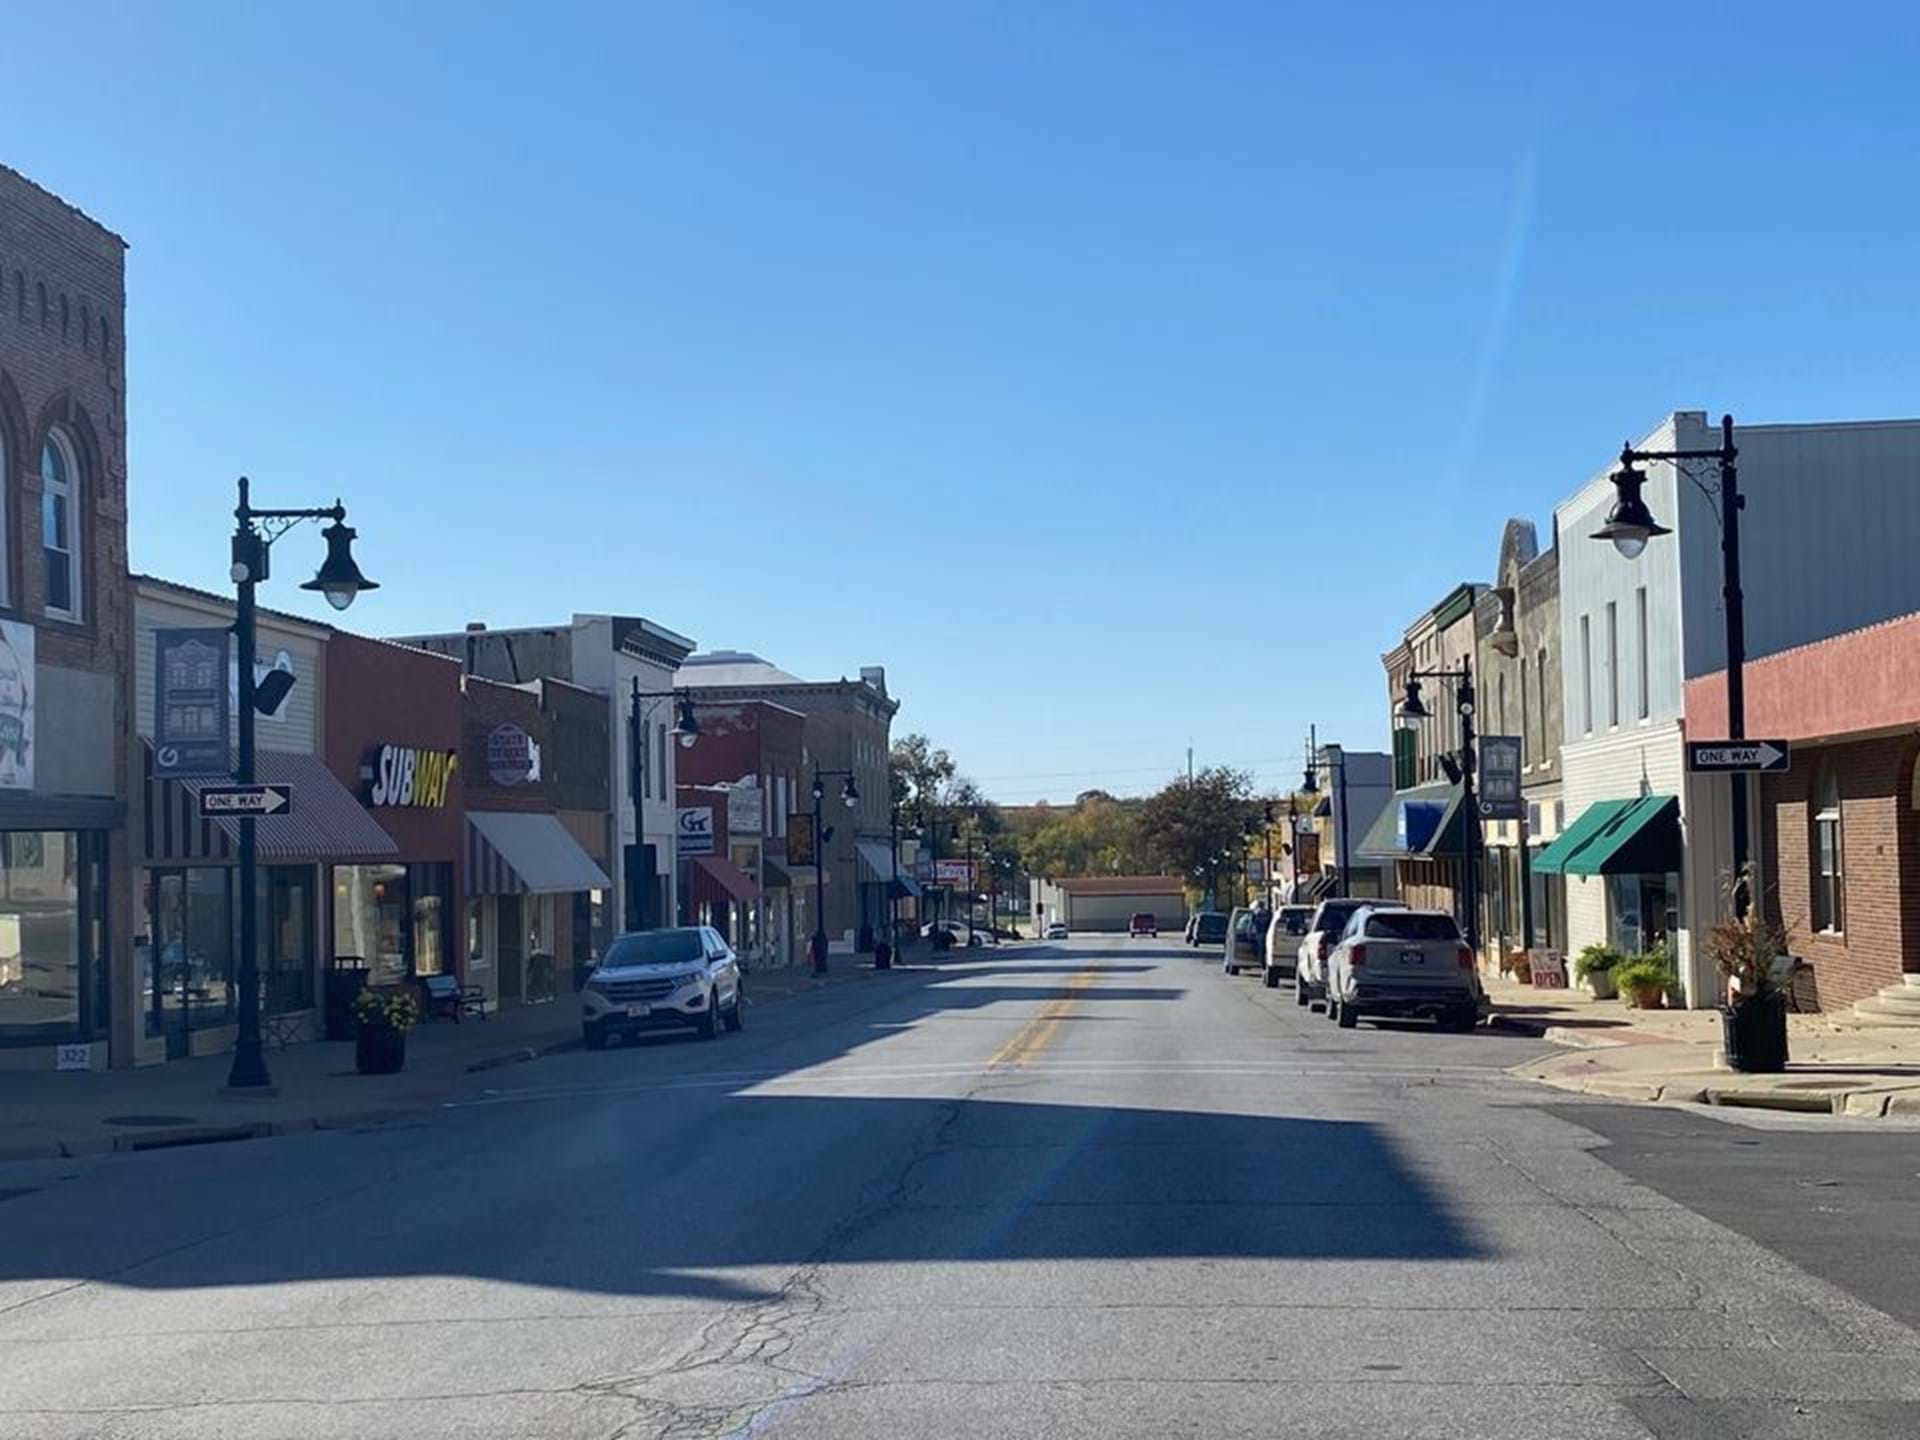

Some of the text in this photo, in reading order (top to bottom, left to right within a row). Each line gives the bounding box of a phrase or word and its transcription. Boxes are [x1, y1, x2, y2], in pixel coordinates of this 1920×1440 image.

[1699, 750, 1759, 762] ONE WAY
[372, 744, 457, 807] SUBWAY
[208, 795, 263, 807] ONE WAY
